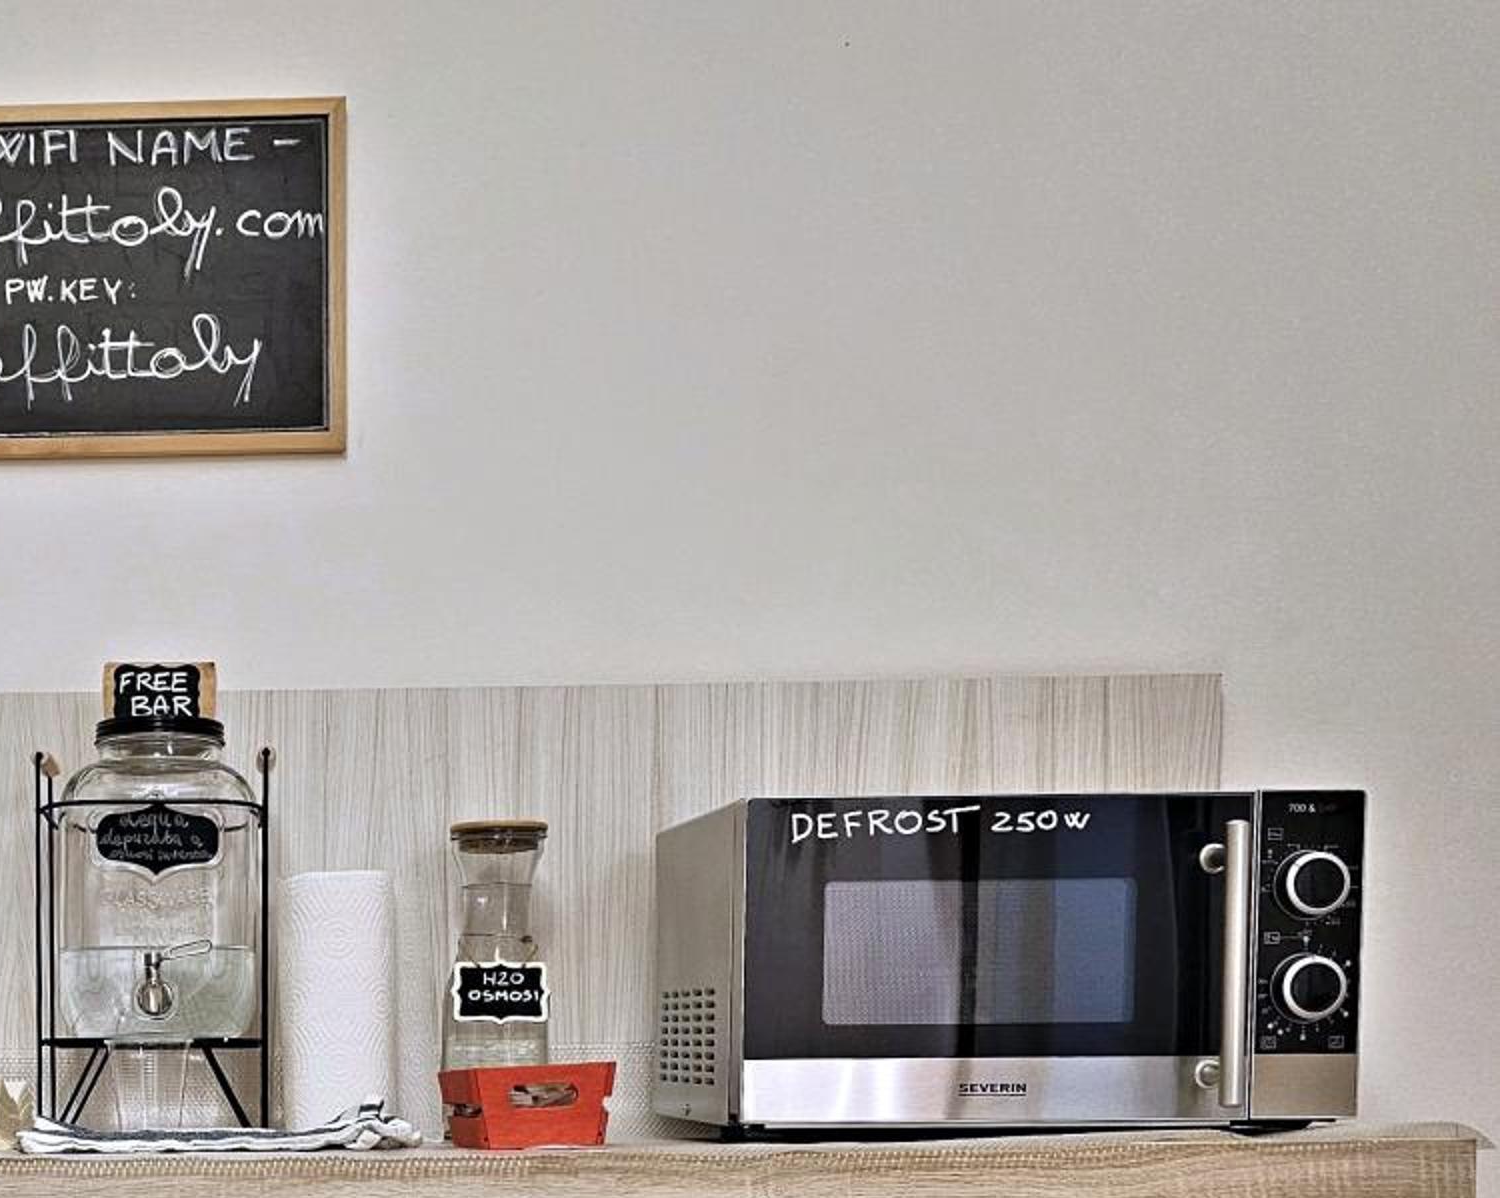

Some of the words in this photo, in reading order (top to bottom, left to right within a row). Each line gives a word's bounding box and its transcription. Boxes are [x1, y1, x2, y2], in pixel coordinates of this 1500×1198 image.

[107, 127, 256, 166] NAME
[119, 671, 188, 694] FREE
[131, 694, 193, 717] BAR
[791, 805, 980, 844] DEFROST
[467, 990, 539, 1003] OSMOSI
[958, 1083, 1027, 1093] SEVERIN
